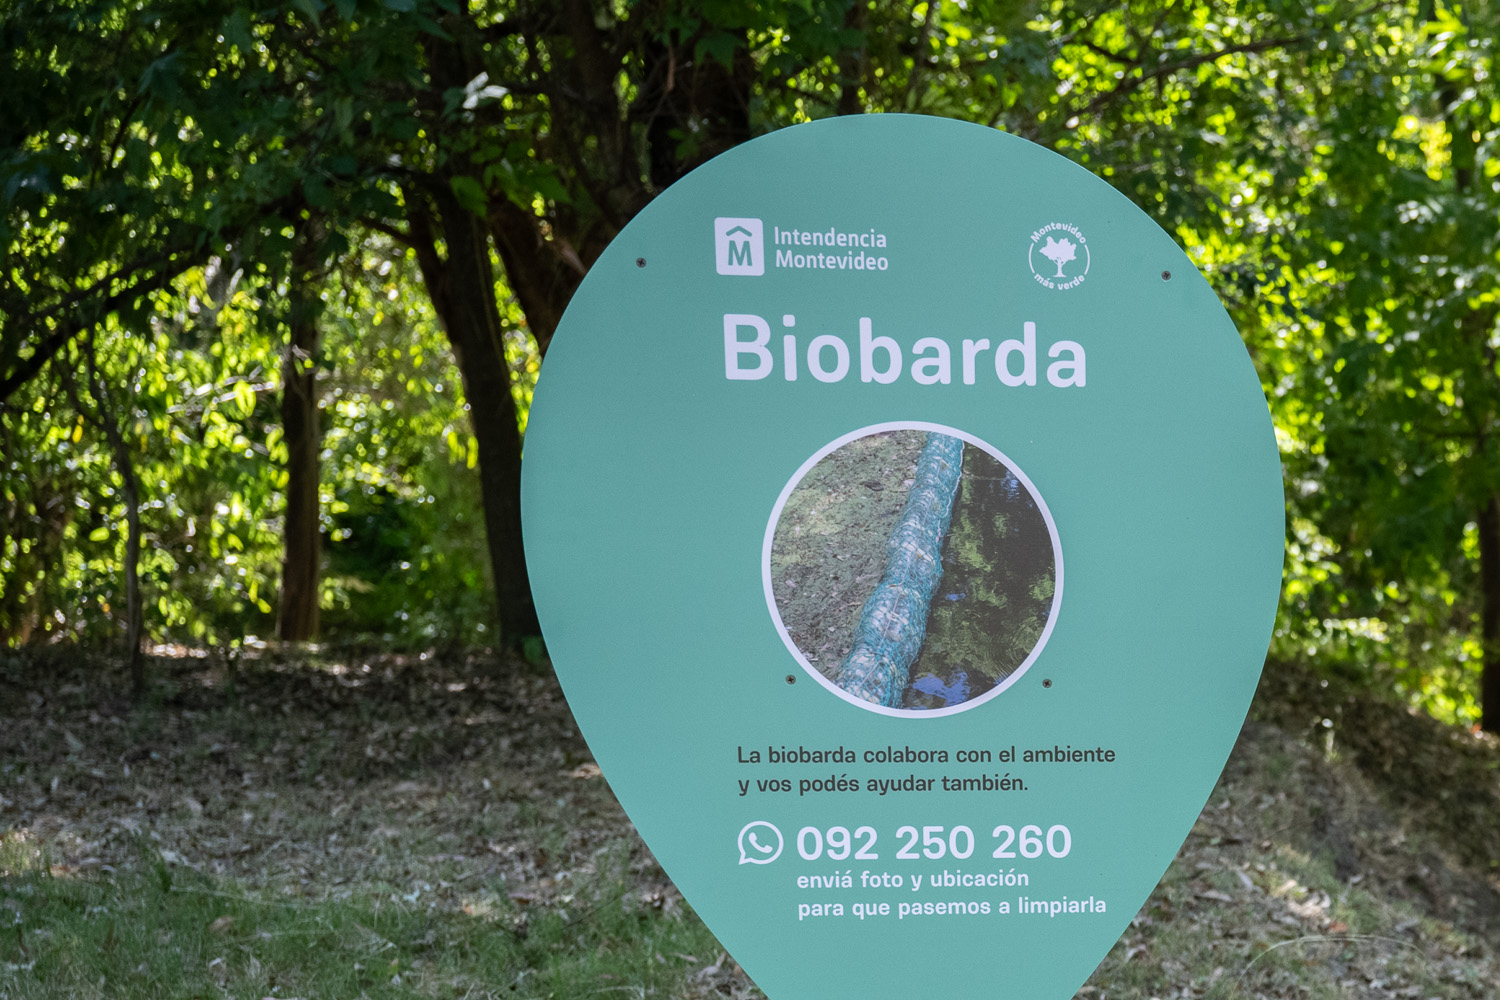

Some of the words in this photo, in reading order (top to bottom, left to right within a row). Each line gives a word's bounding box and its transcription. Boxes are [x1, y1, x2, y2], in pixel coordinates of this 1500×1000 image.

[775, 227, 886, 247] Intendencia
[1030, 222, 1086, 243] Montevideo
[776, 250, 888, 270] Montevideo
[1034, 273, 1054, 289] más
[1057, 275, 1085, 290] verde
[724, 314, 1086, 387] Biobarda
[738, 746, 760, 763] La
[768, 746, 855, 764] biobarda
[864, 746, 948, 765] colabora
[957, 750, 991, 762] con
[999, 746, 1015, 762] el
[1023, 745, 1115, 762] ambiente
[738, 780, 749, 796] y
[757, 780, 791, 792] vos
[800, 774, 859, 796] podés
[867, 774, 935, 795] ayudar
[941, 773, 1028, 791] también.
[797, 826, 878, 860] 092
[896, 826, 974, 859] 250
[993, 825, 1071, 858] 260
[797, 870, 852, 888] enviá
[861, 871, 903, 887] foto
[911, 875, 922, 891] y
[931, 869, 1028, 887] ubicación
[799, 904, 843, 920] para
[853, 903, 889, 919] que
[899, 902, 990, 919] pasemos
[999, 902, 1009, 913] a
[1019, 896, 1105, 917] limpiarla
